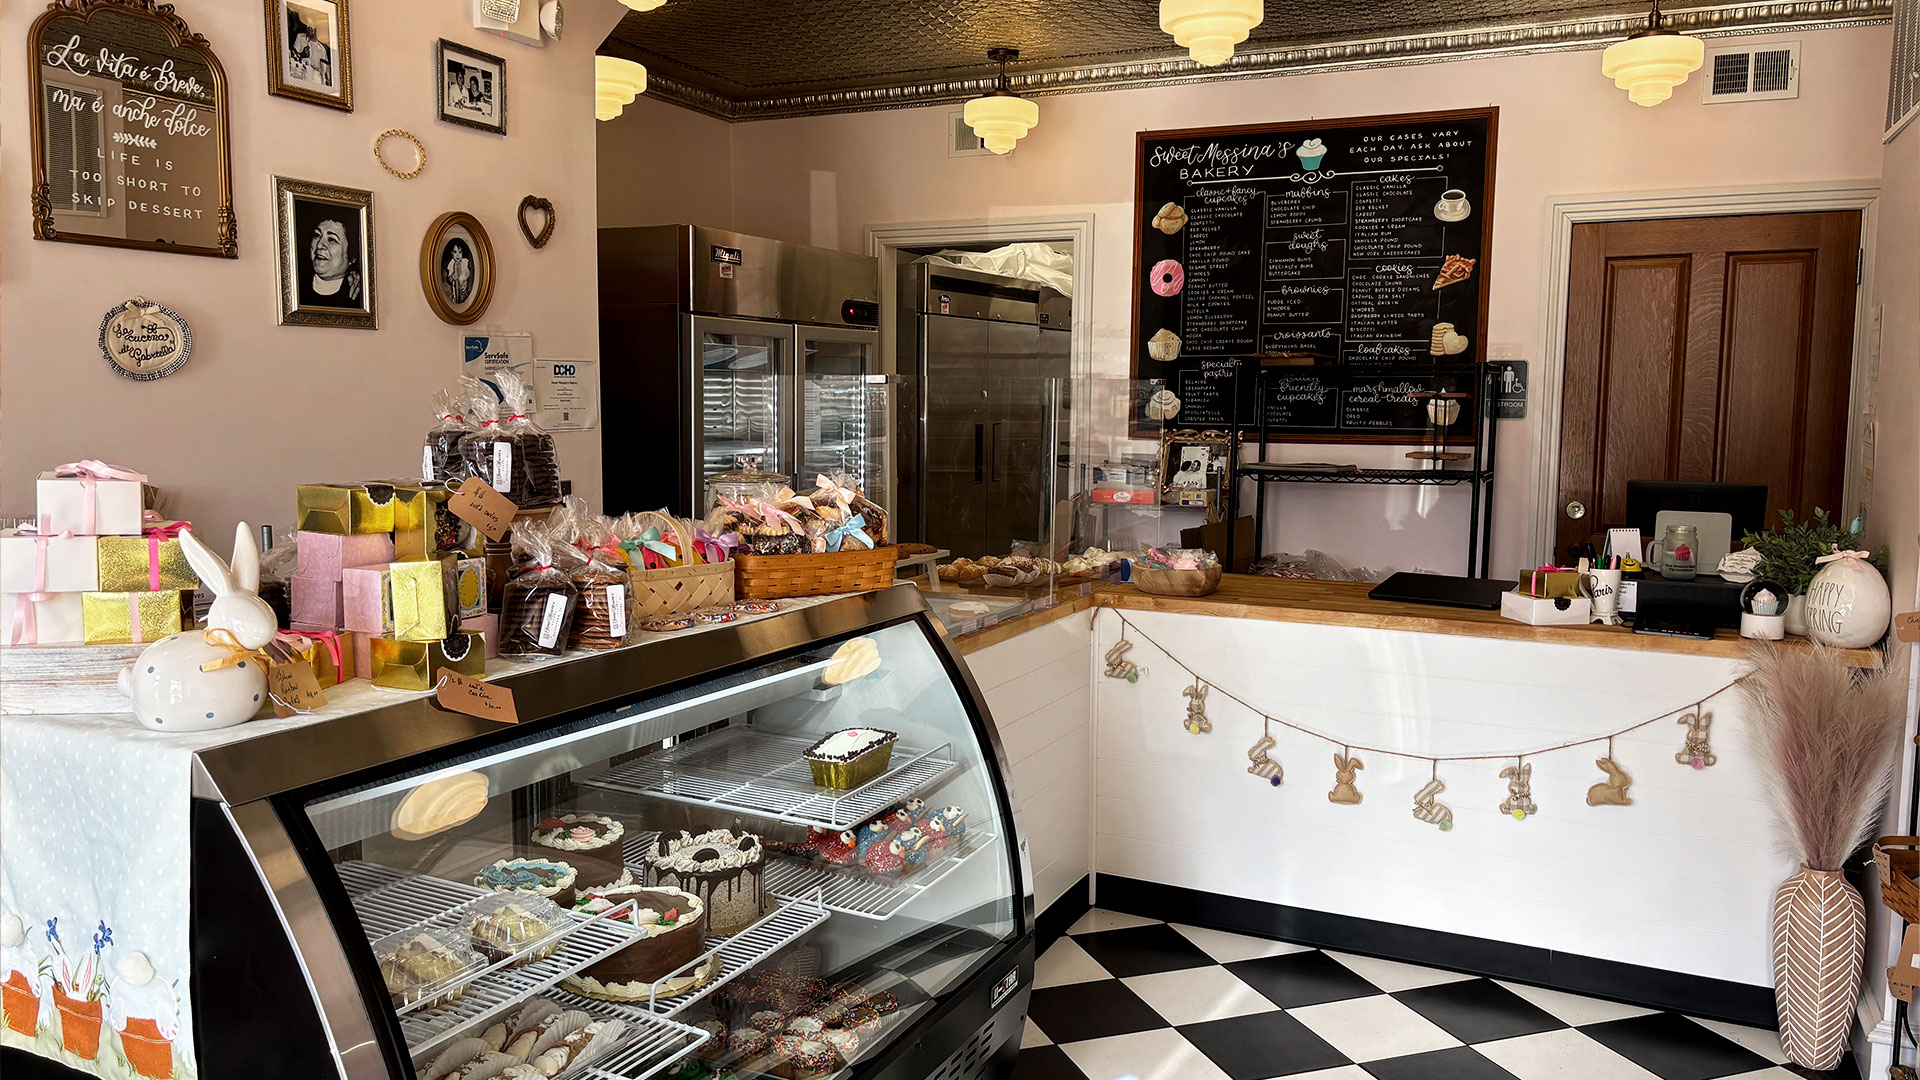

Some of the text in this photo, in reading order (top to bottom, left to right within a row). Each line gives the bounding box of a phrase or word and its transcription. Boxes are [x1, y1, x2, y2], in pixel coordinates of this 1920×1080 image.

[47, 35, 90, 76] La
[96, 48, 139, 79] vita
[151, 59, 205, 98] breve,
[53, 89, 211, 136] ma é anche dolce
[1438, 140, 1472, 148] ABOUT
[97, 147, 173, 171] LIFE IS
[1150, 141, 1296, 167] Sweet Messina's
[1390, 153, 1450, 162] SPECIALS!
[1180, 164, 1254, 180] BAKERY
[69, 169, 201, 197] TOO SHORT TO
[1379, 174, 1415, 184] cakes
[1286, 186, 1331, 198] muffins
[72, 192, 203, 220] SKIP DESSERT
[1204, 194, 1248, 206] cupcakes
[1293, 228, 1324, 240] sweet
[1288, 238, 1328, 254] doughs
[1375, 263, 1414, 275] cookies
[1281, 285, 1331, 296] brownies
[1274, 328, 1334, 340] croissants
[1357, 343, 1411, 356] loaf cakes
[554, 365, 575, 375] DCHD
[1353, 381, 1424, 394] marshmallow
[1277, 393, 1326, 405] cupcakes
[1349, 394, 1380, 403] cereal
[1590, 574, 1613, 598] Paris
[1808, 582, 1844, 608] HAPPY
